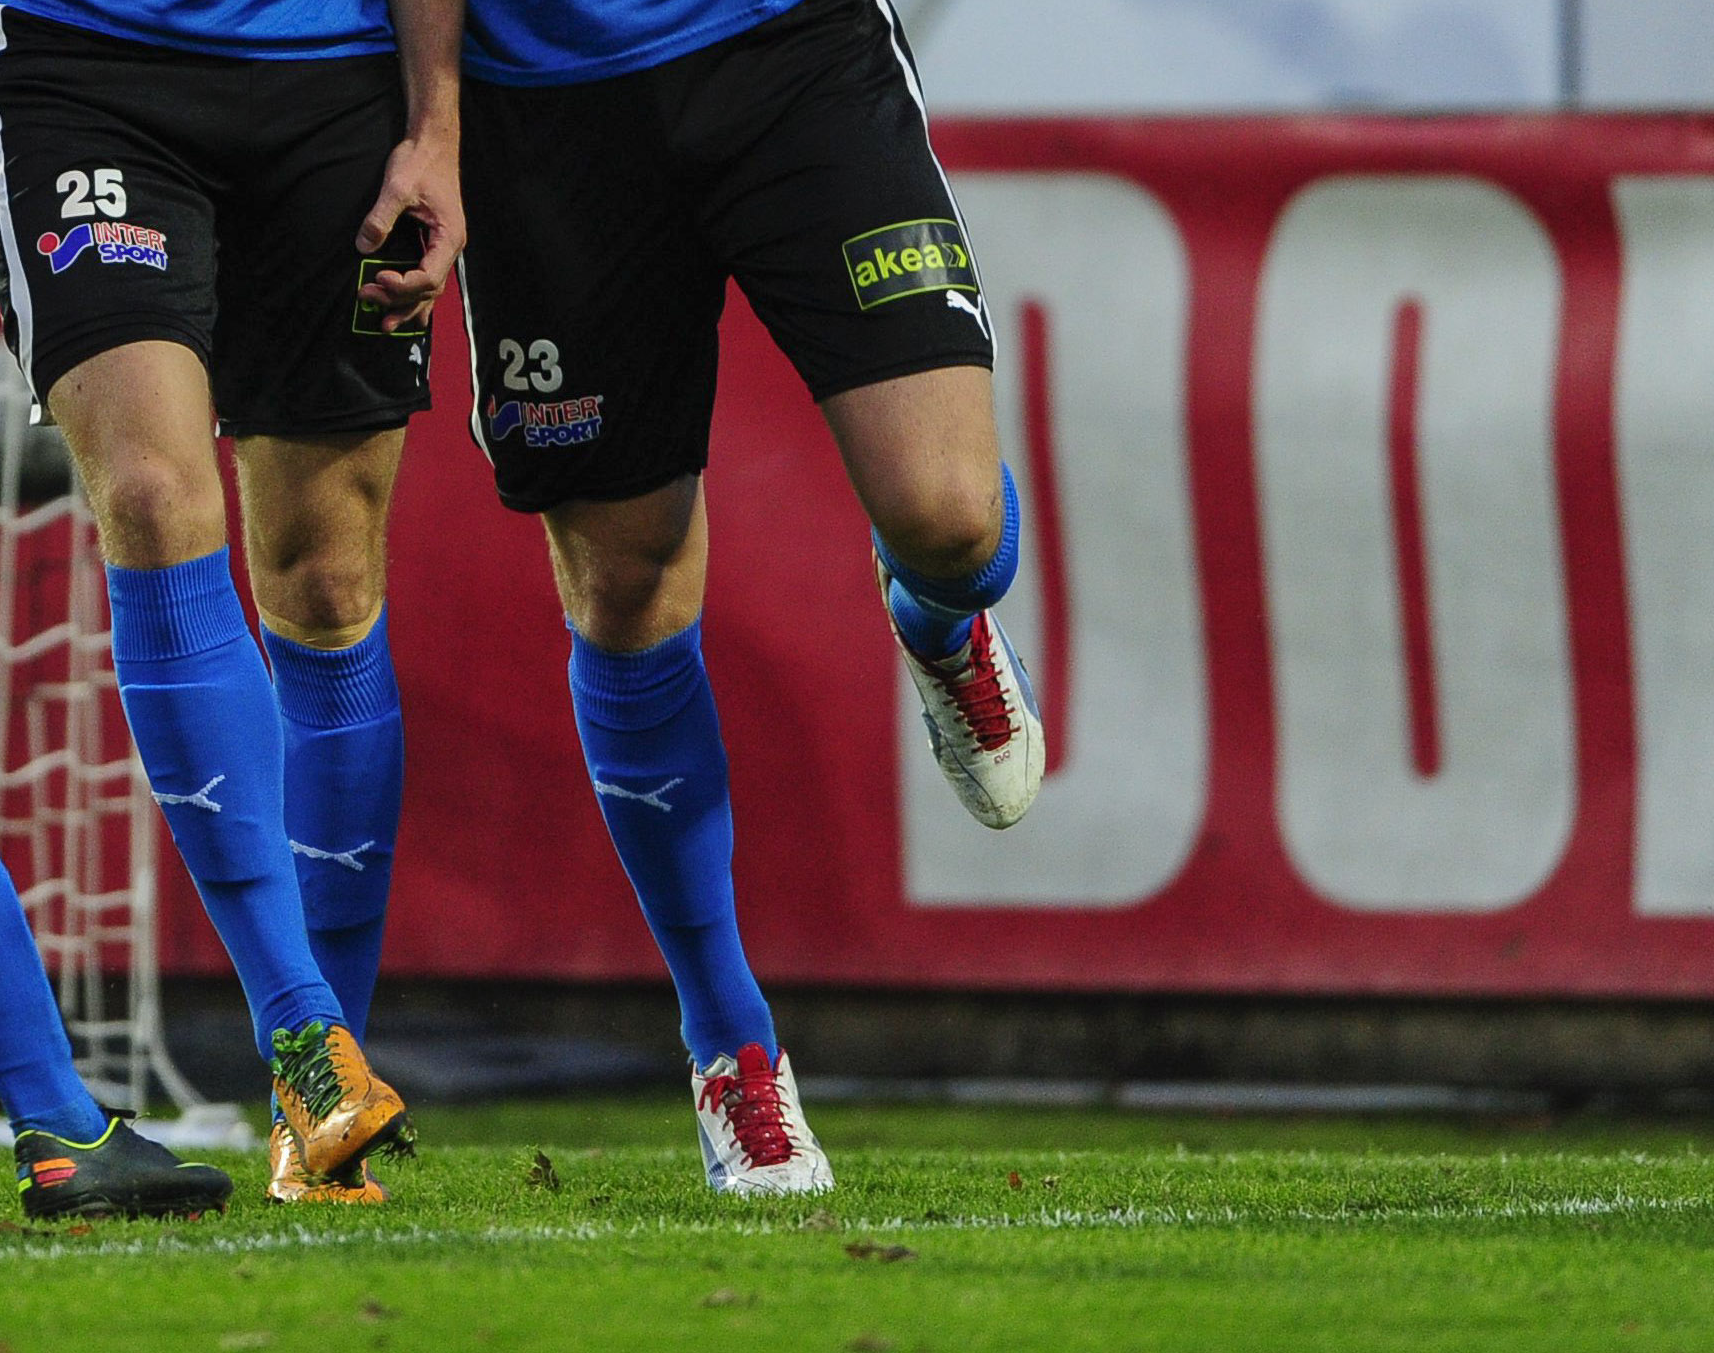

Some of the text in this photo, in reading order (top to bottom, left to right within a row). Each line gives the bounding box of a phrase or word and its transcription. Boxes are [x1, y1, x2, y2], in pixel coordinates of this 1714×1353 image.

[55, 168, 127, 219] 25
[93, 222, 165, 253] INTER
[97, 243, 168, 271] SPORT
[855, 243, 945, 288] akea
[499, 338, 564, 394] 23
[522, 396, 600, 427] INTER
[524, 415, 603, 448] SPORT
